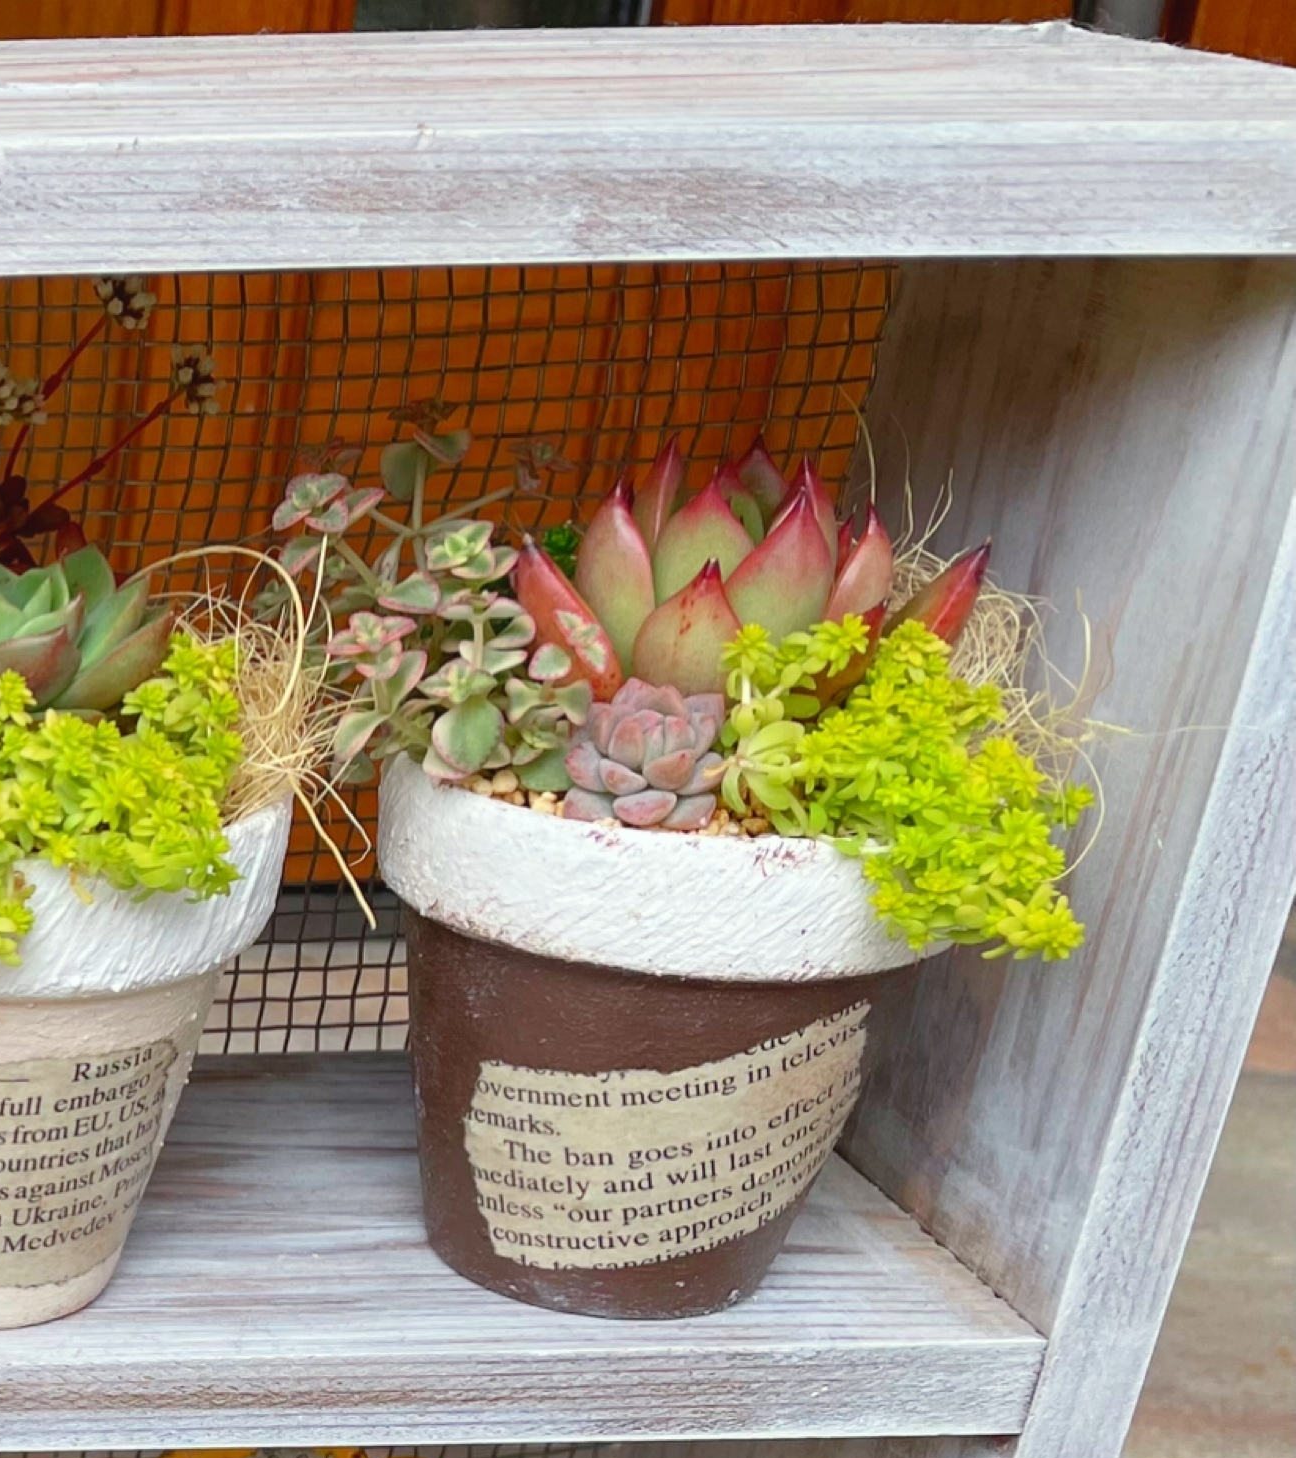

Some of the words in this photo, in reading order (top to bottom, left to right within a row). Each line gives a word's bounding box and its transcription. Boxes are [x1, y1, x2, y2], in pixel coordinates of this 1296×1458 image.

[72, 1046, 152, 1083] Russia
[621, 1075, 738, 1108] meeting
[747, 1064, 770, 1085] in
[54, 1074, 151, 1113] embargo
[13, 1125, 68, 1144] from
[96, 1131, 131, 1158] that
[504, 1139, 552, 1165] The
[565, 1147, 614, 1166] ban
[628, 1140, 694, 1170] goes
[707, 1125, 756, 1151] into
[768, 1084, 833, 1130] effect
[604, 1172, 653, 1194] and
[667, 1158, 717, 1186] will
[729, 1142, 772, 1172] last
[781, 1117, 820, 1148] one
[15, 1170, 95, 1203] against
[622, 1182, 733, 1226] partners
[1, 1210, 119, 1254] Medvedev
[493, 1226, 649, 1250] constructive
[659, 1190, 772, 1244] approach
